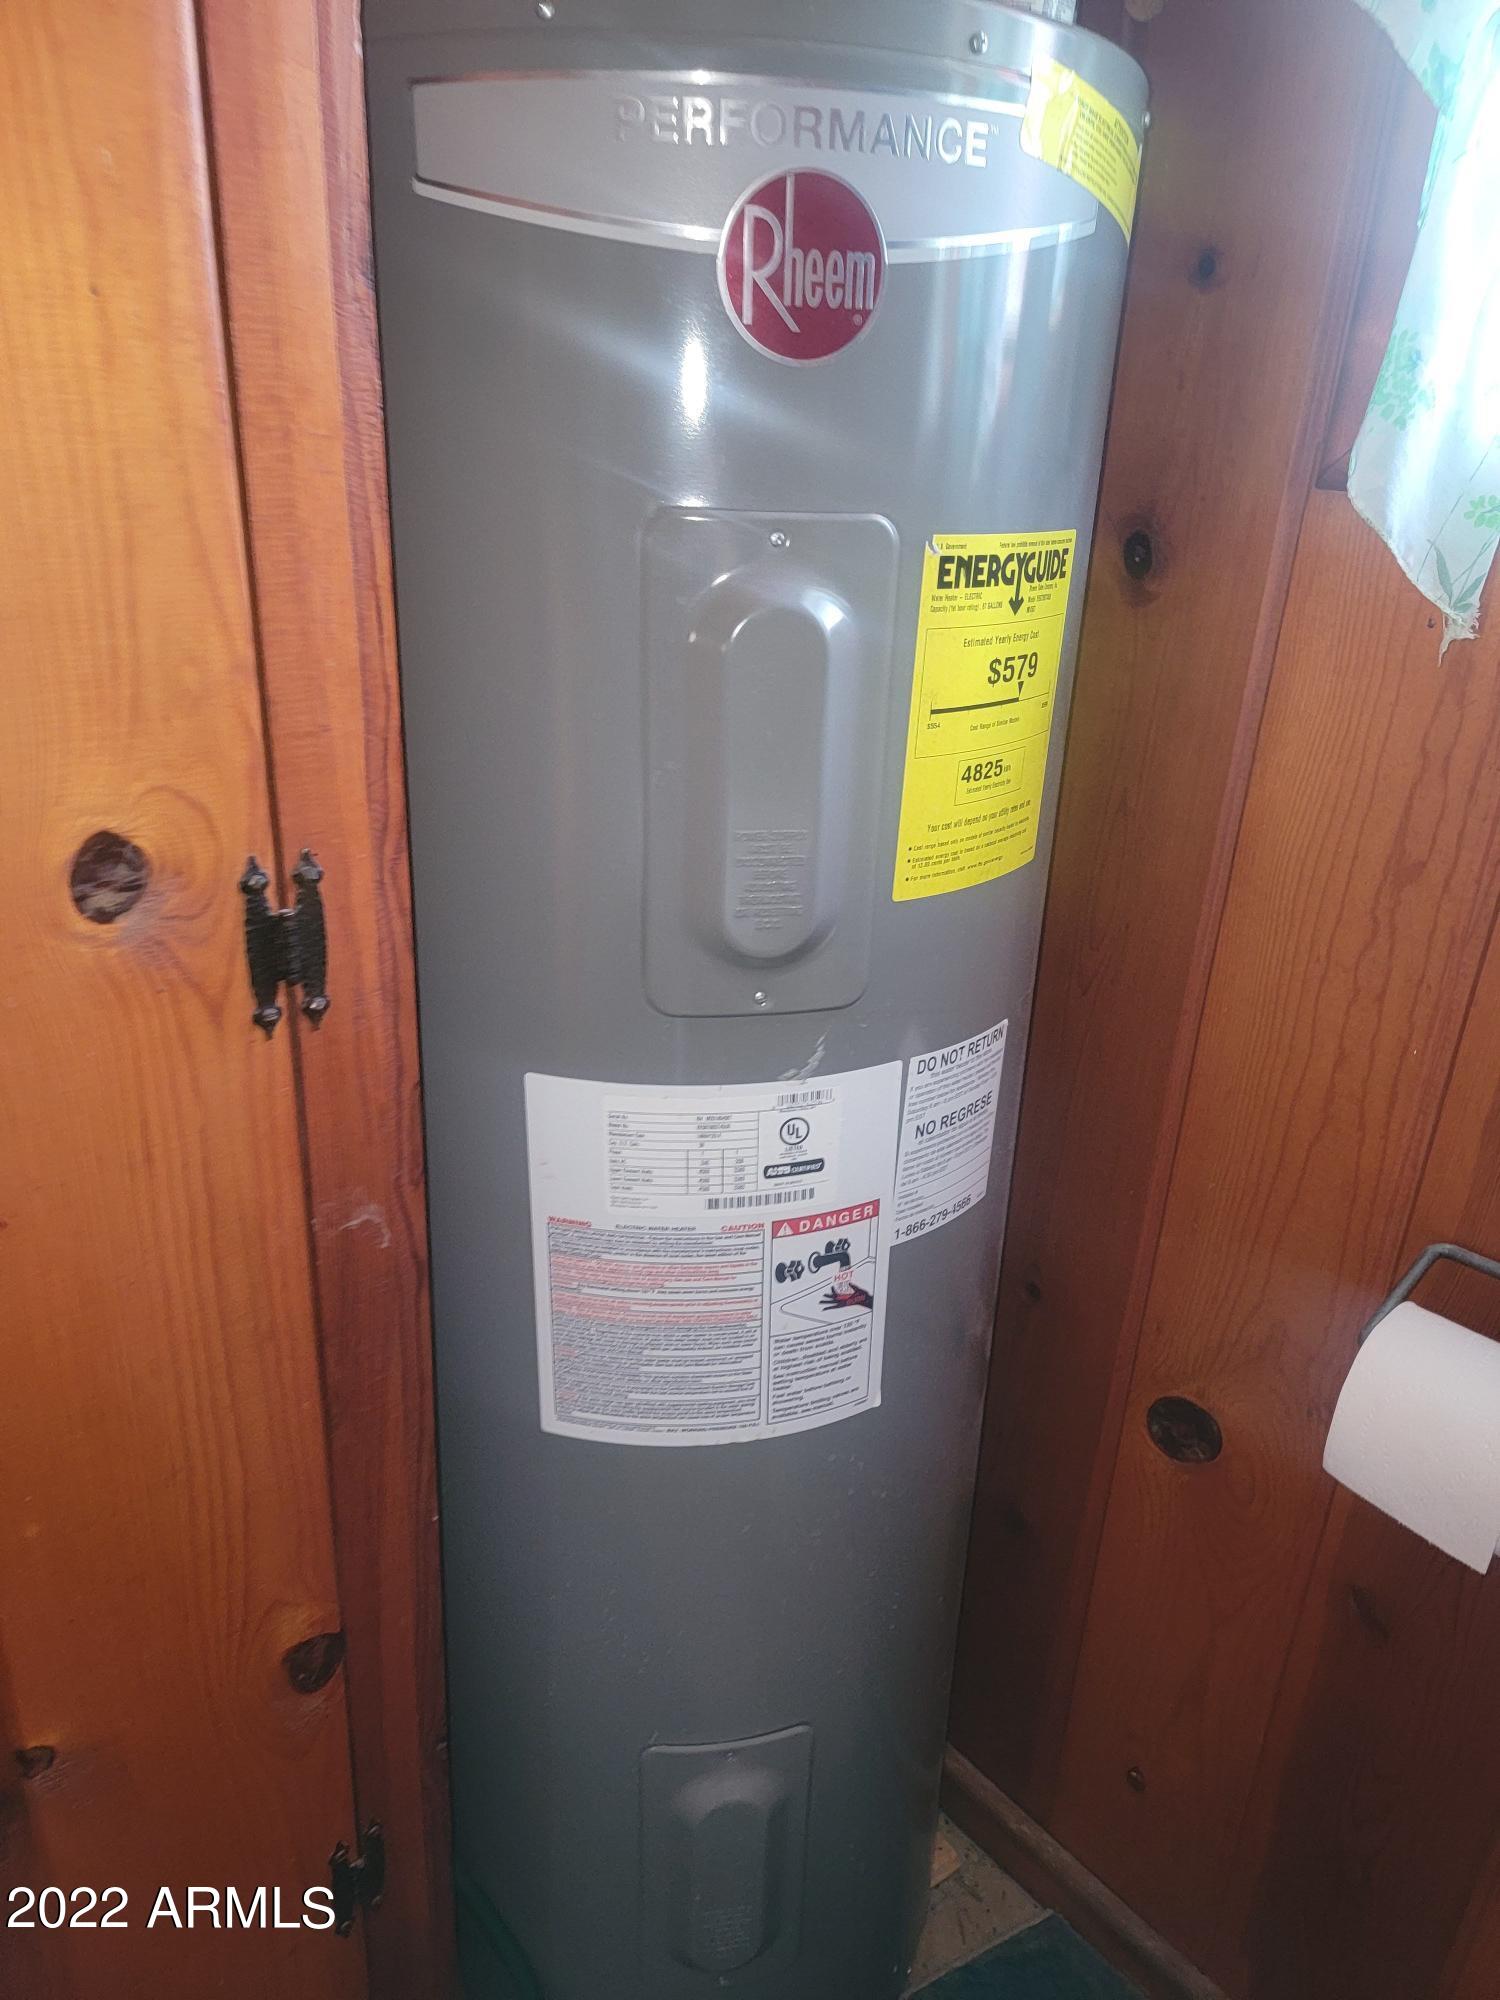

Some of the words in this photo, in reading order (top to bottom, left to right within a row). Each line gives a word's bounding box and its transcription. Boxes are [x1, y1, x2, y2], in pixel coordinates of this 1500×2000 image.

[743, 176, 874, 333] Rheem
[937, 548, 1069, 589] ENERGYGUIDE
[964, 637, 992, 648] Estimated
[995, 634, 1011, 646] Yearly
[1013, 632, 1029, 642] Energy
[988, 652, 1038, 688] $579
[961, 758, 1003, 784] 4825
[928, 824, 940, 833] Your
[942, 821, 952, 830] cost
[964, 814, 981, 827] depend
[917, 1056, 937, 1075] DO
[940, 1046, 965, 1068] NOT
[968, 1024, 1004, 1057] RETURN
[915, 1120, 936, 1139] NO
[940, 1090, 992, 1130] REGRESE
[787, 1123, 802, 1139] UL
[720, 1221, 764, 1233] CAUTION
[799, 1204, 874, 1233] DANGER
[834, 1270, 854, 1282] HOT
